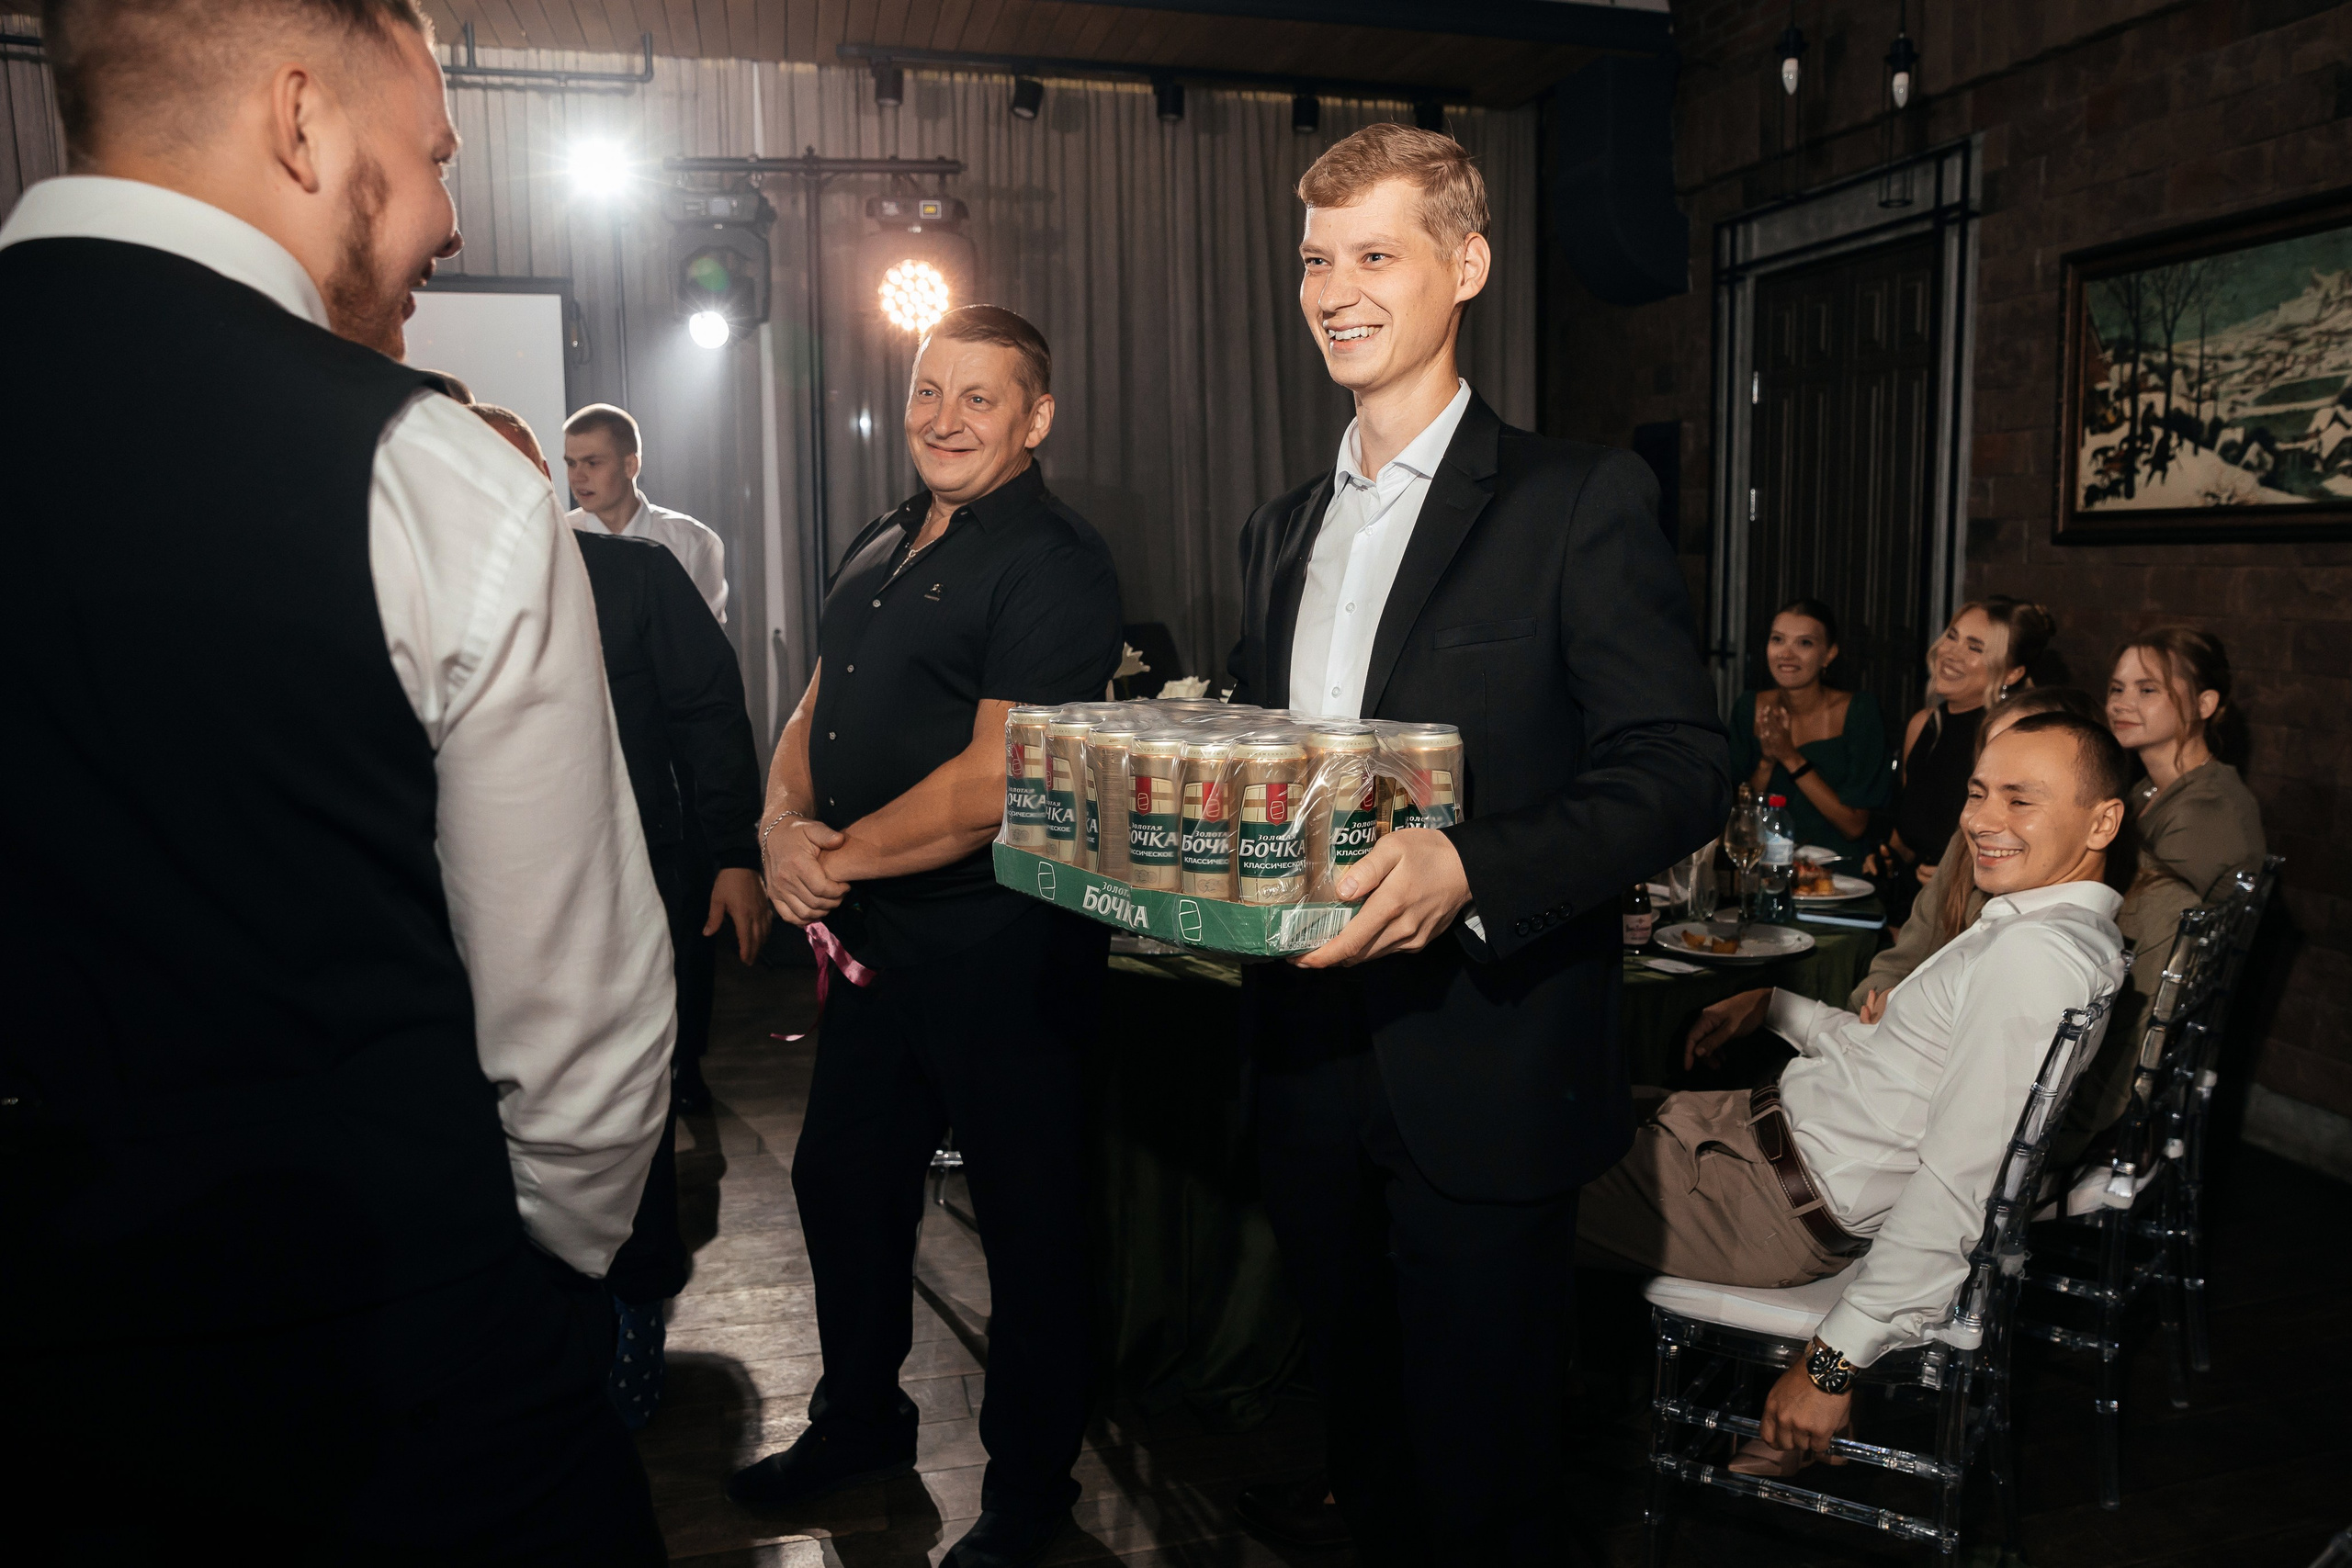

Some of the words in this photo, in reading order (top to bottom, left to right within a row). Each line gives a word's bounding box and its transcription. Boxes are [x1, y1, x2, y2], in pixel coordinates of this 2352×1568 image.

[1007, 793, 1046, 809] ОЧКА
[1129, 829, 1179, 848] ОЧКА
[1332, 827, 1377, 845] БОЧК
[1238, 839, 1306, 858] БОЧКА
[1184, 856, 1229, 865] КЛАССИЧЕС
[1082, 885, 1150, 929] БОЧКА
